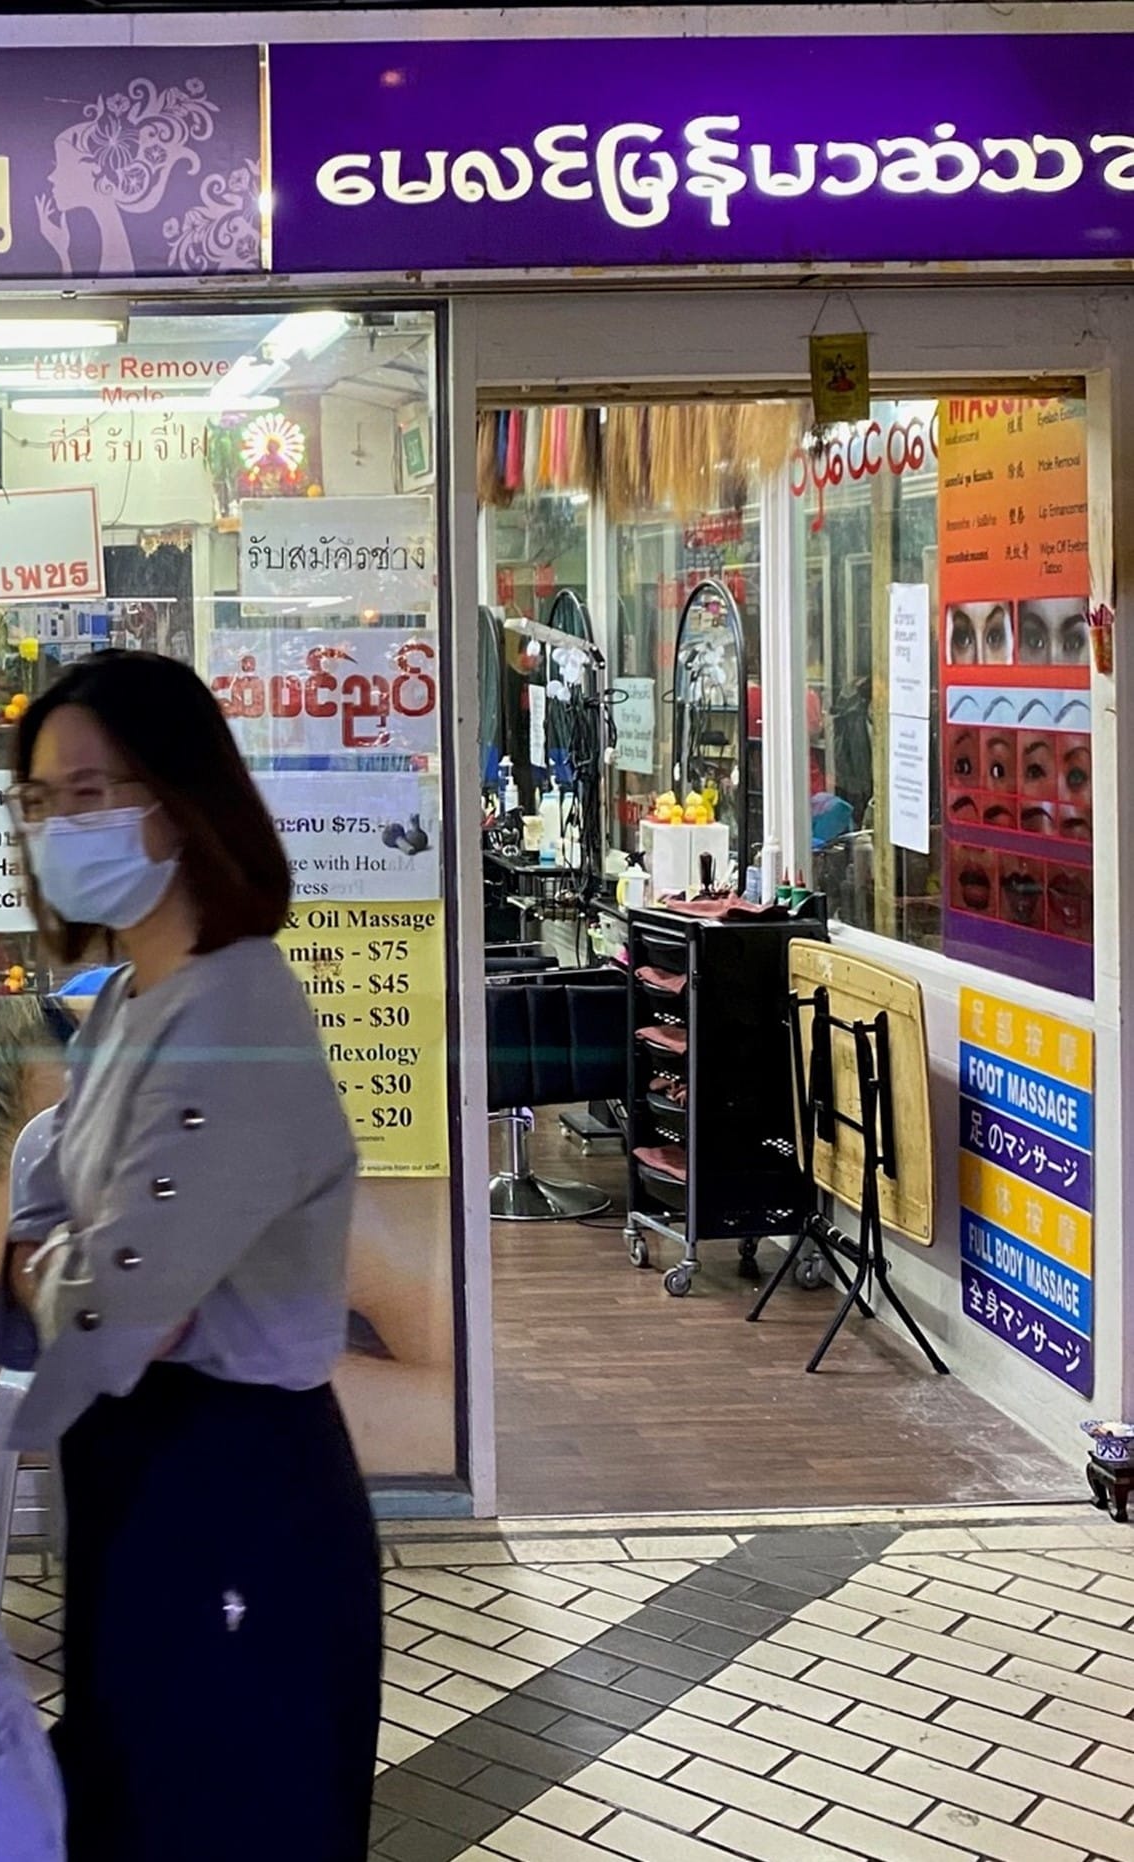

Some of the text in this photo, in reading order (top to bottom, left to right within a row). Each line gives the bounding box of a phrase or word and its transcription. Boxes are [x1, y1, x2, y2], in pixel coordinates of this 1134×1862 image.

[120, 357, 229, 379] Remove
[314, 855, 351, 871] with
[355, 855, 387, 871] Hot
[291, 880, 329, 895] ress
[282, 910, 436, 933] & Oil Massage
[289, 942, 345, 962] mins
[367, 940, 409, 961] $75
[368, 973, 410, 994] $45
[314, 1009, 346, 1028] ins
[369, 1006, 411, 1027] $30
[327, 1043, 422, 1066] flexology
[370, 1074, 412, 1095] $30
[968, 1055, 1078, 1133] FOOT MASSAGE
[371, 1107, 413, 1129] $20
[968, 1221, 1081, 1318] FULL BODY MASSAGE
